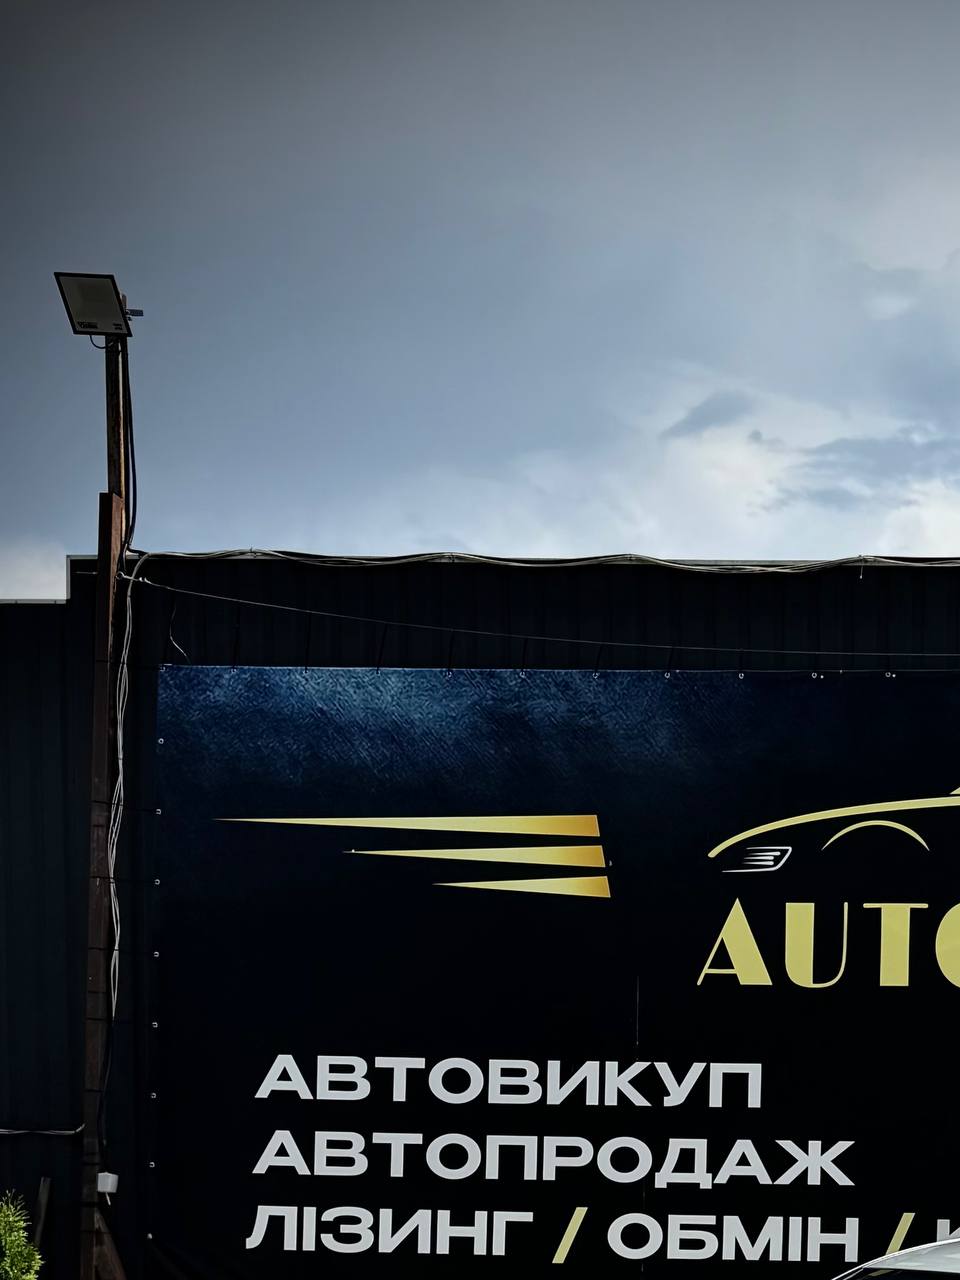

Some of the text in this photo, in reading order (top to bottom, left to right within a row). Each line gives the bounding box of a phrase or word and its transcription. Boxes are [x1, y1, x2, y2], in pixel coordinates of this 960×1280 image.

[254, 1054, 762, 1109] АВТОВИКУП
[251, 1129, 856, 1190] АВТОПРОДАЖ
[245, 1205, 534, 1256] ЛІЗИНГ
[551, 1206, 588, 1264] /
[607, 1212, 860, 1263] ОБМІН
